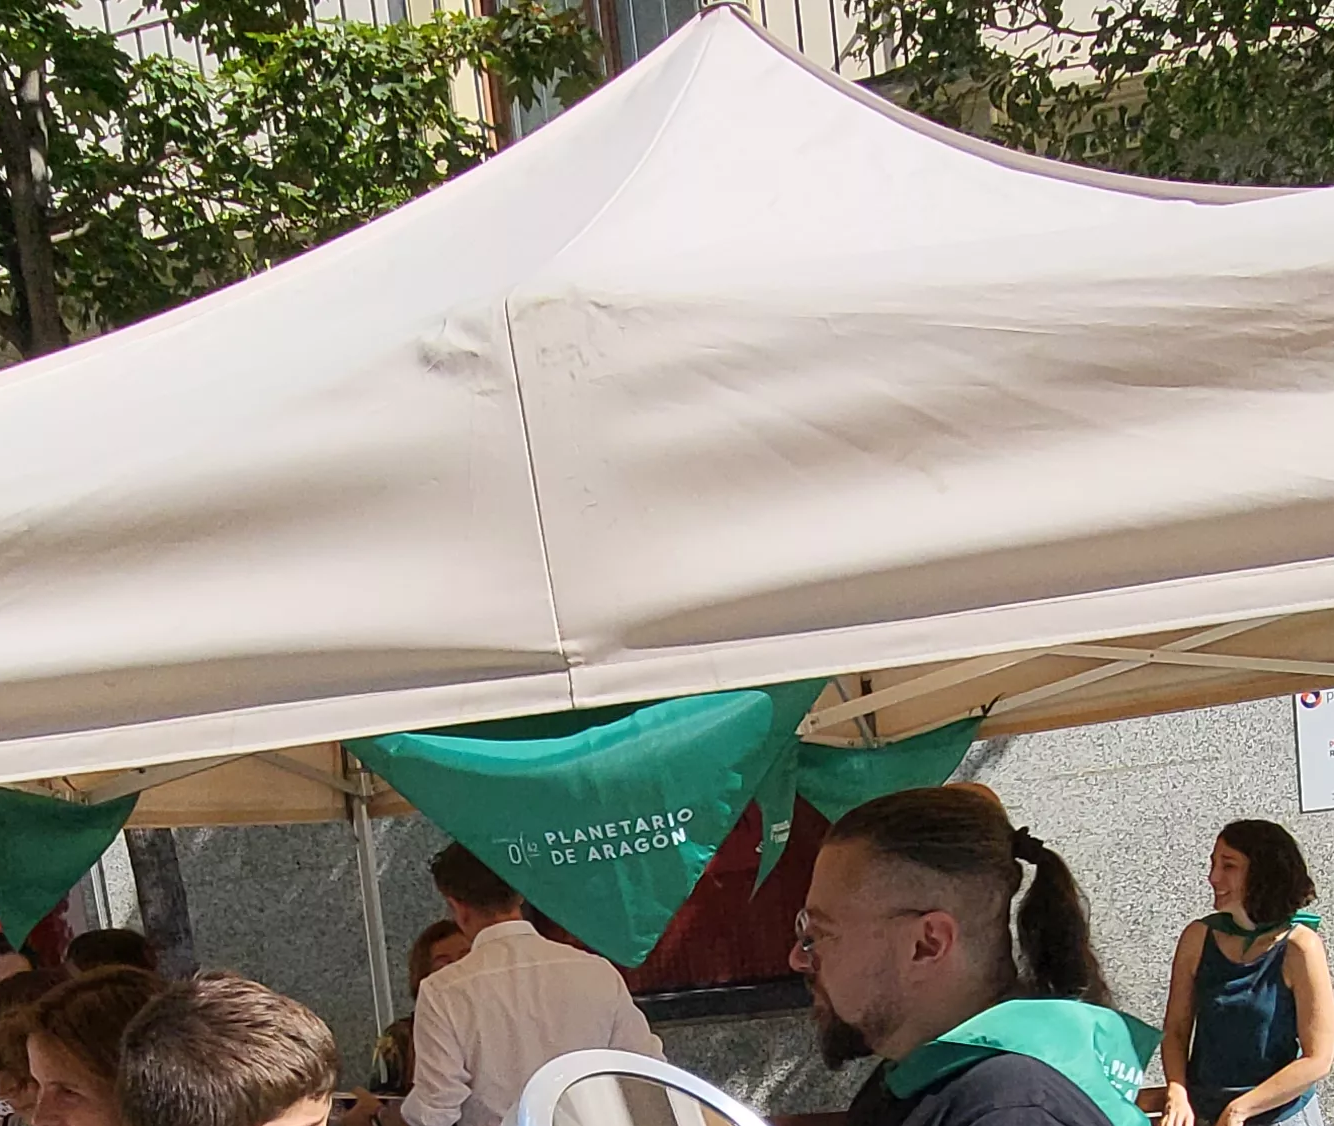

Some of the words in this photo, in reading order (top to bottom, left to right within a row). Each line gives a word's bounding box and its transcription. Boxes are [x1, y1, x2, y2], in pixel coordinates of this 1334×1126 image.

[543, 807, 694, 846] PLANETARIO
[550, 848, 578, 865] DE
[587, 827, 687, 862] ARAGÓN
